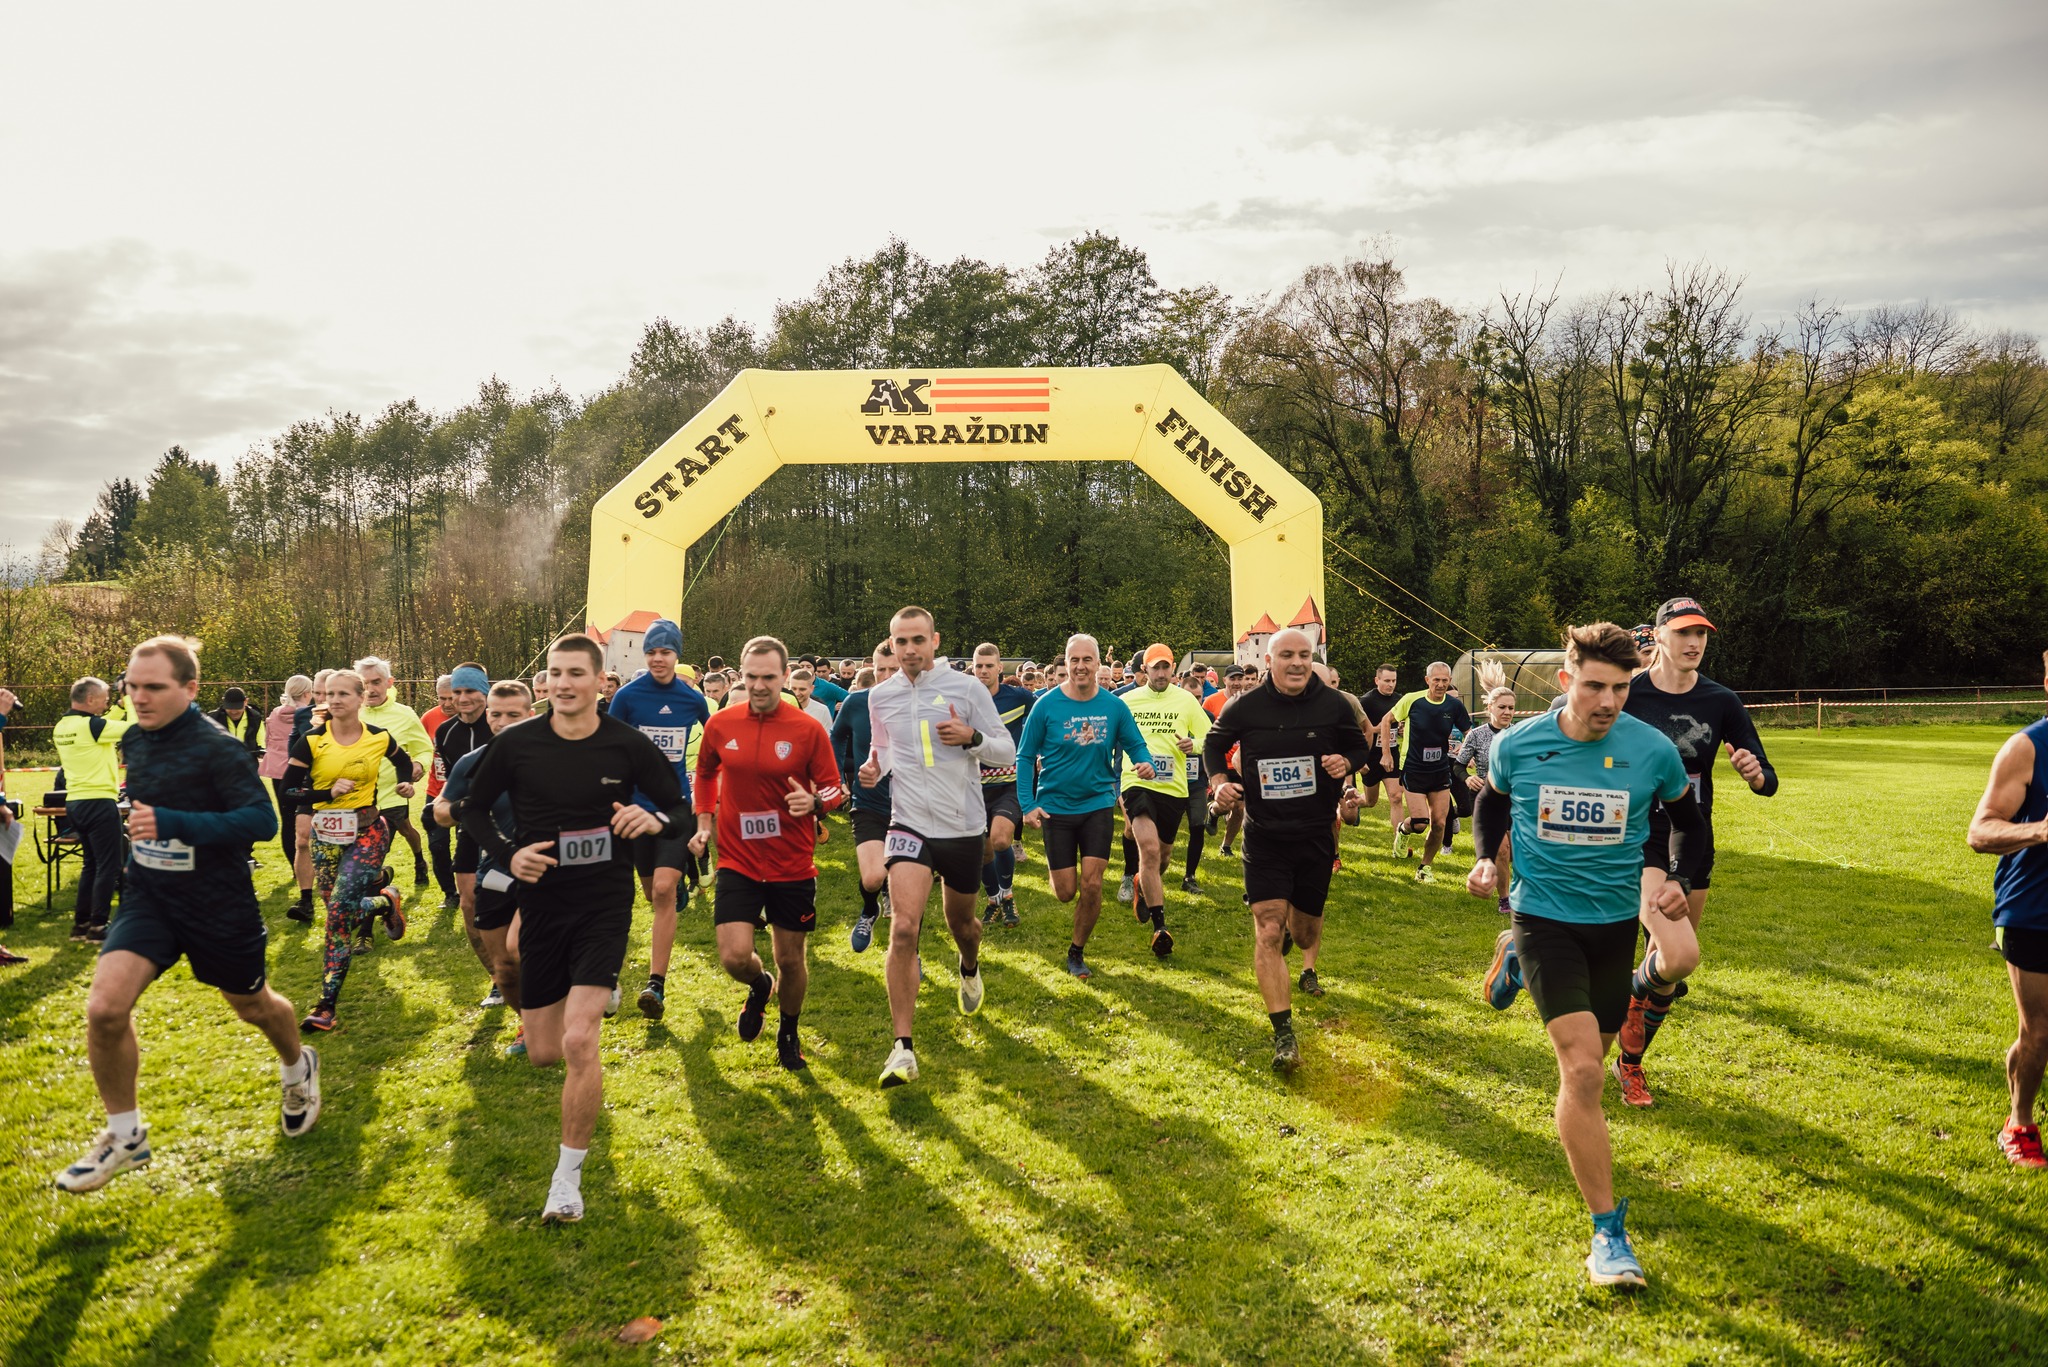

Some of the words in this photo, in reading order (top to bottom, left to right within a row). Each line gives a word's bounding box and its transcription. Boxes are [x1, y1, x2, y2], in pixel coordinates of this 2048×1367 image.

[861, 379, 931, 416] AK
[865, 416, 1049, 446] VARAŽDIN
[634, 414, 750, 519] START
[1155, 407, 1278, 523] FINISH
[1133, 712, 1161, 720] PRIZMA
[1164, 712, 1180, 720] V&V
[653, 734, 674, 748] 551
[1425, 750, 1441, 760] 040
[1272, 766, 1301, 783] 564
[1561, 800, 1606, 824] 566
[322, 817, 343, 831] 231
[745, 818, 777, 835] 006
[566, 837, 607, 859] 007
[889, 837, 918, 853] 035
